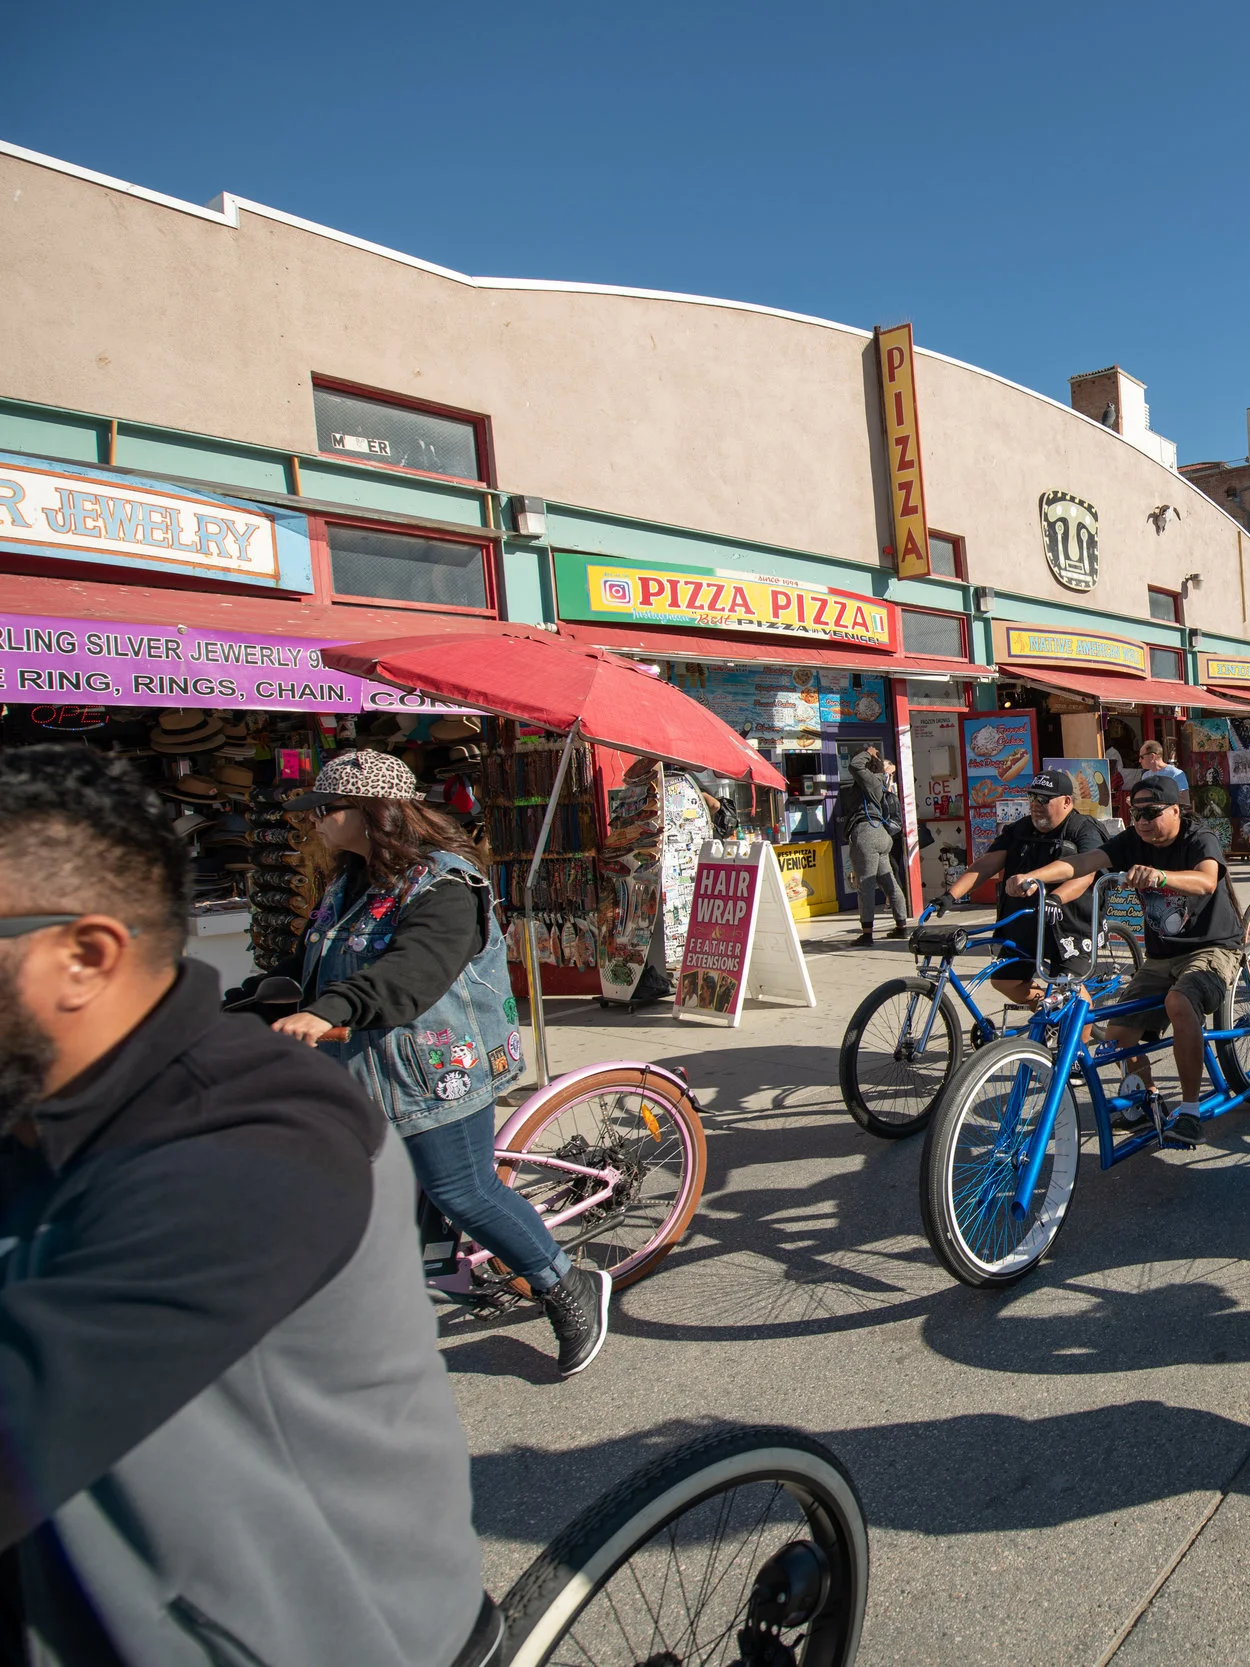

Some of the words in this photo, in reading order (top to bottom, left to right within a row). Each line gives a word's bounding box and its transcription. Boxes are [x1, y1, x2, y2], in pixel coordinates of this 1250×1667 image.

[886, 345, 924, 562] PIZZA
[41, 487, 259, 562] JEWELRY
[637, 576, 756, 616] PIZZA
[770, 588, 870, 633] PIZZA
[736, 618, 809, 633] PIZZA
[85, 632, 184, 662] SILVER
[190, 640, 303, 670] JEWERLY
[1028, 636, 1073, 654] NATIVE
[17, 669, 122, 697] RING,
[132, 674, 247, 701] RINGS,
[254, 680, 353, 703] CHAIN.
[31, 705, 110, 724] OPE
[928, 780, 951, 796] ICE
[700, 869, 750, 897] HAIR
[697, 897, 747, 925] WRAP
[1106, 906, 1127, 916] Cream
[689, 938, 742, 957] FEATHER
[686, 953, 740, 971] EXTENSIONS
